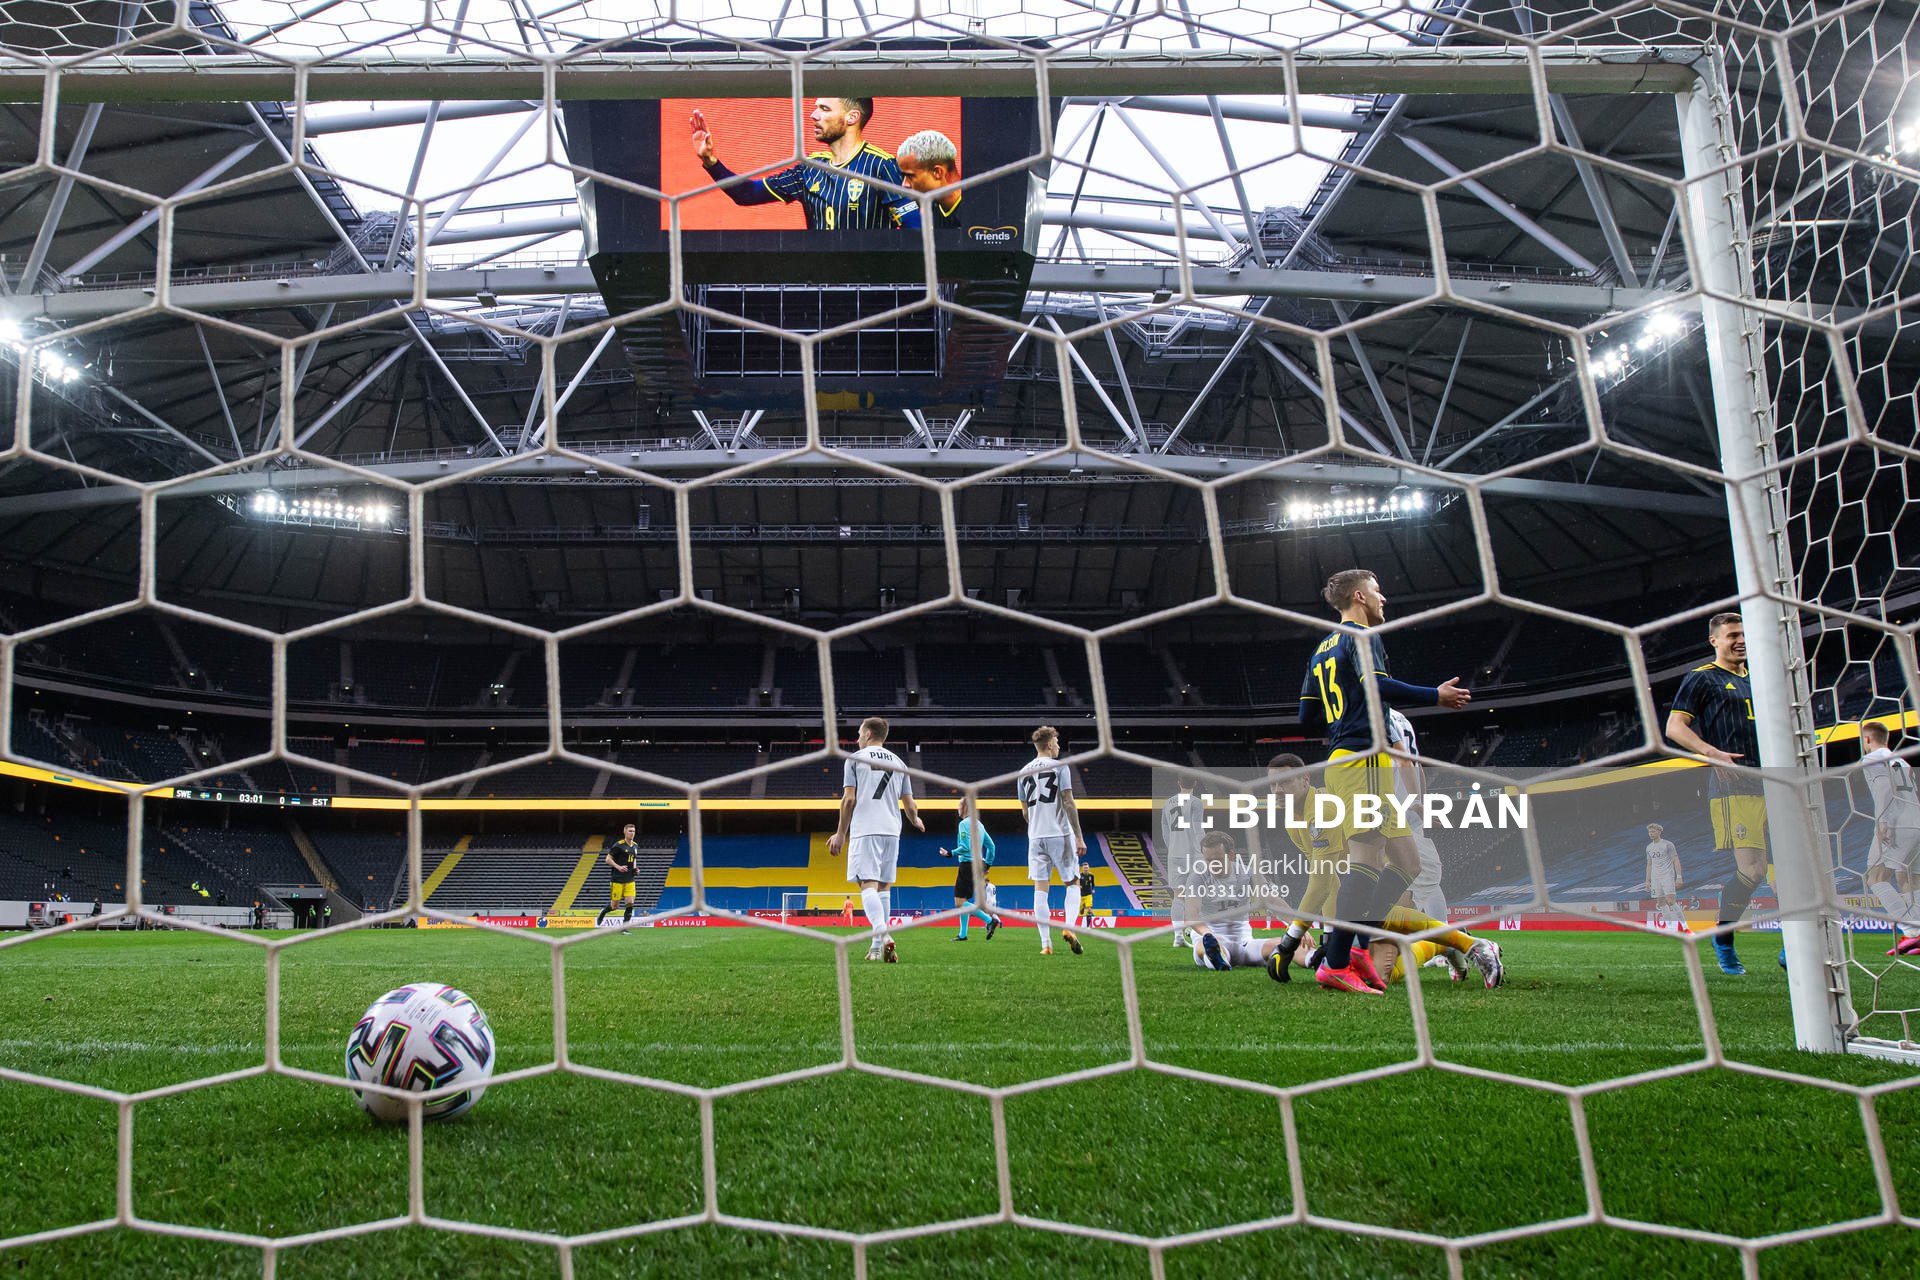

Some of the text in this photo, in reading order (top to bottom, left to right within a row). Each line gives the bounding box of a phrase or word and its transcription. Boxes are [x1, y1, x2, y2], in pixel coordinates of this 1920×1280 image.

[975, 230, 1011, 241] friends
[1312, 656, 1344, 724] 13
[869, 751, 893, 761] PURI
[870, 764, 894, 800] 7
[1022, 771, 1059, 808] 23
[176, 789, 329, 806] SWE 0 03:01 0 EST
[490, 919, 529, 927] BAUHAUS
